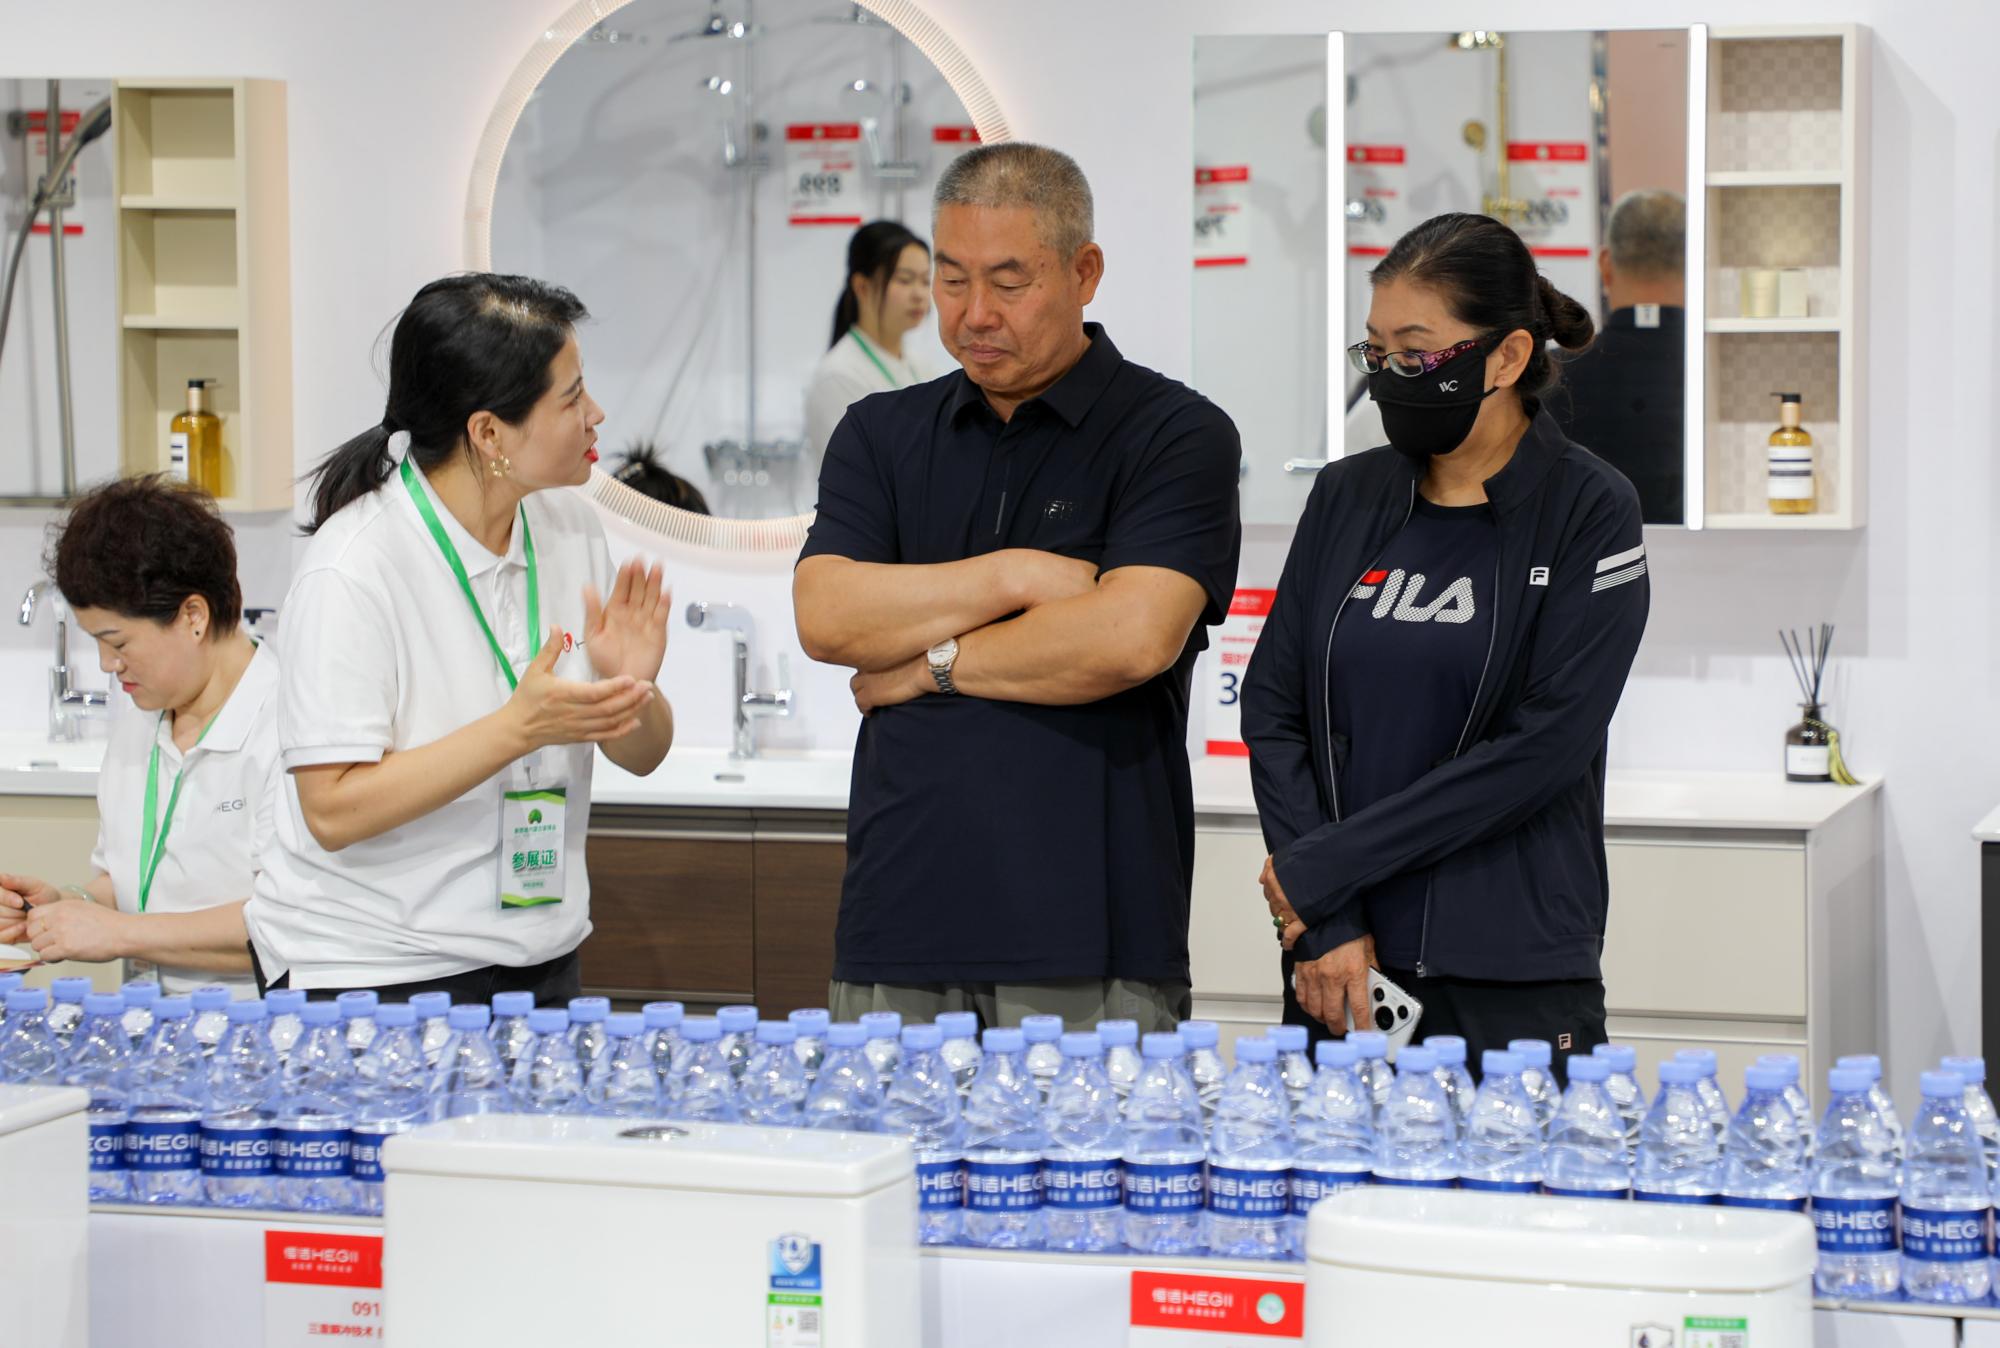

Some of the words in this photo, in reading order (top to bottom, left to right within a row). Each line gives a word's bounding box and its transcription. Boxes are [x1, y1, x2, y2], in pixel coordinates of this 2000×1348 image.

[1351, 568, 1476, 624] FILA
[512, 849, 556, 871] 参展证
